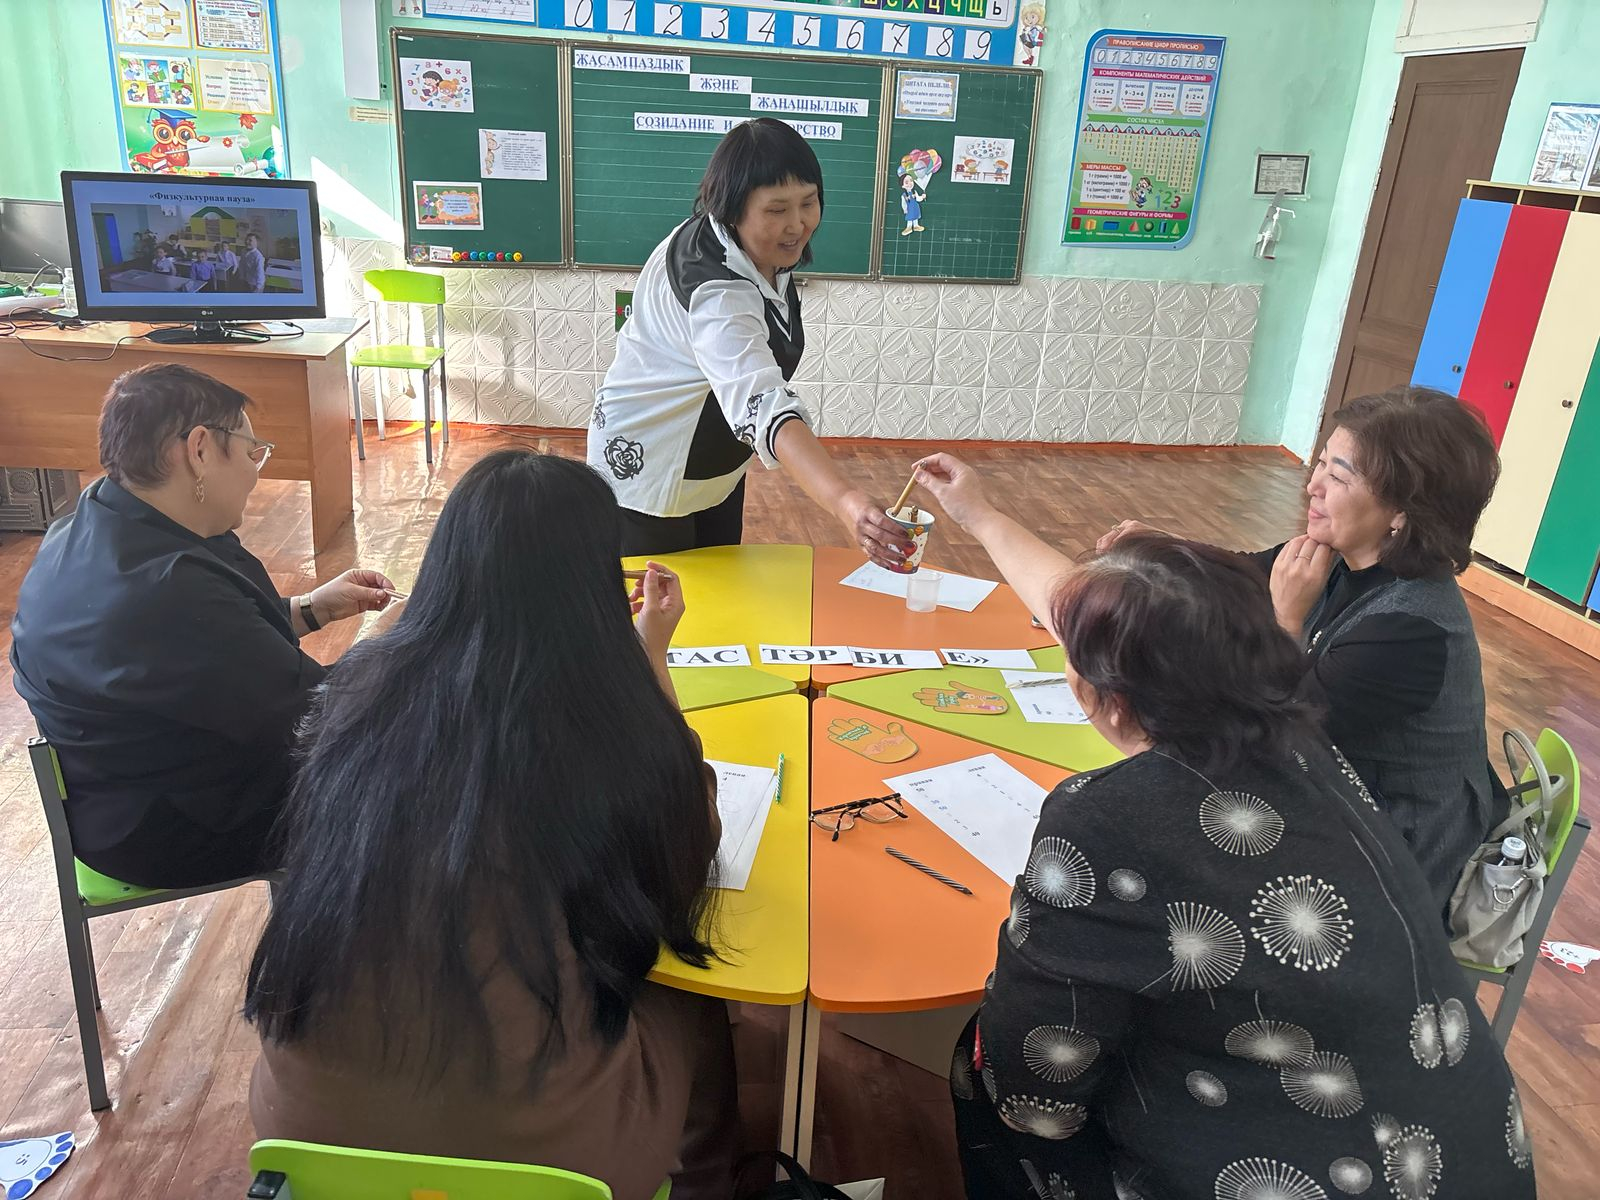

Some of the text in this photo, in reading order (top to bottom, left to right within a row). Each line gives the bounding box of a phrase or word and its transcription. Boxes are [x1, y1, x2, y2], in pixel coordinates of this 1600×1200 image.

[623, 0, 636, 32] 1
[662, 4, 683, 36] 2
[711, 8, 730, 39] 3
[758, 12, 775, 43] 4
[797, 16, 821, 46] 5
[846, 19, 866, 50] 6
[891, 23, 910, 53] 7
[936, 27, 955, 57] 8
[973, 30, 992, 60] 9
[1097, 50, 1106, 63] 0
[1122, 52, 1131, 64] 2
[635, 115, 715, 132] СОЗИДАНИЕ
[723, 120, 734, 132] И
[149, 192, 256, 204] «Физкультурная пауза»
[1162, 191, 1172, 204] 2
[1170, 195, 1181, 208] 3
[667, 649, 740, 664] ТАС
[762, 648, 837, 661] ТӘР
[852, 651, 908, 665] БИ
